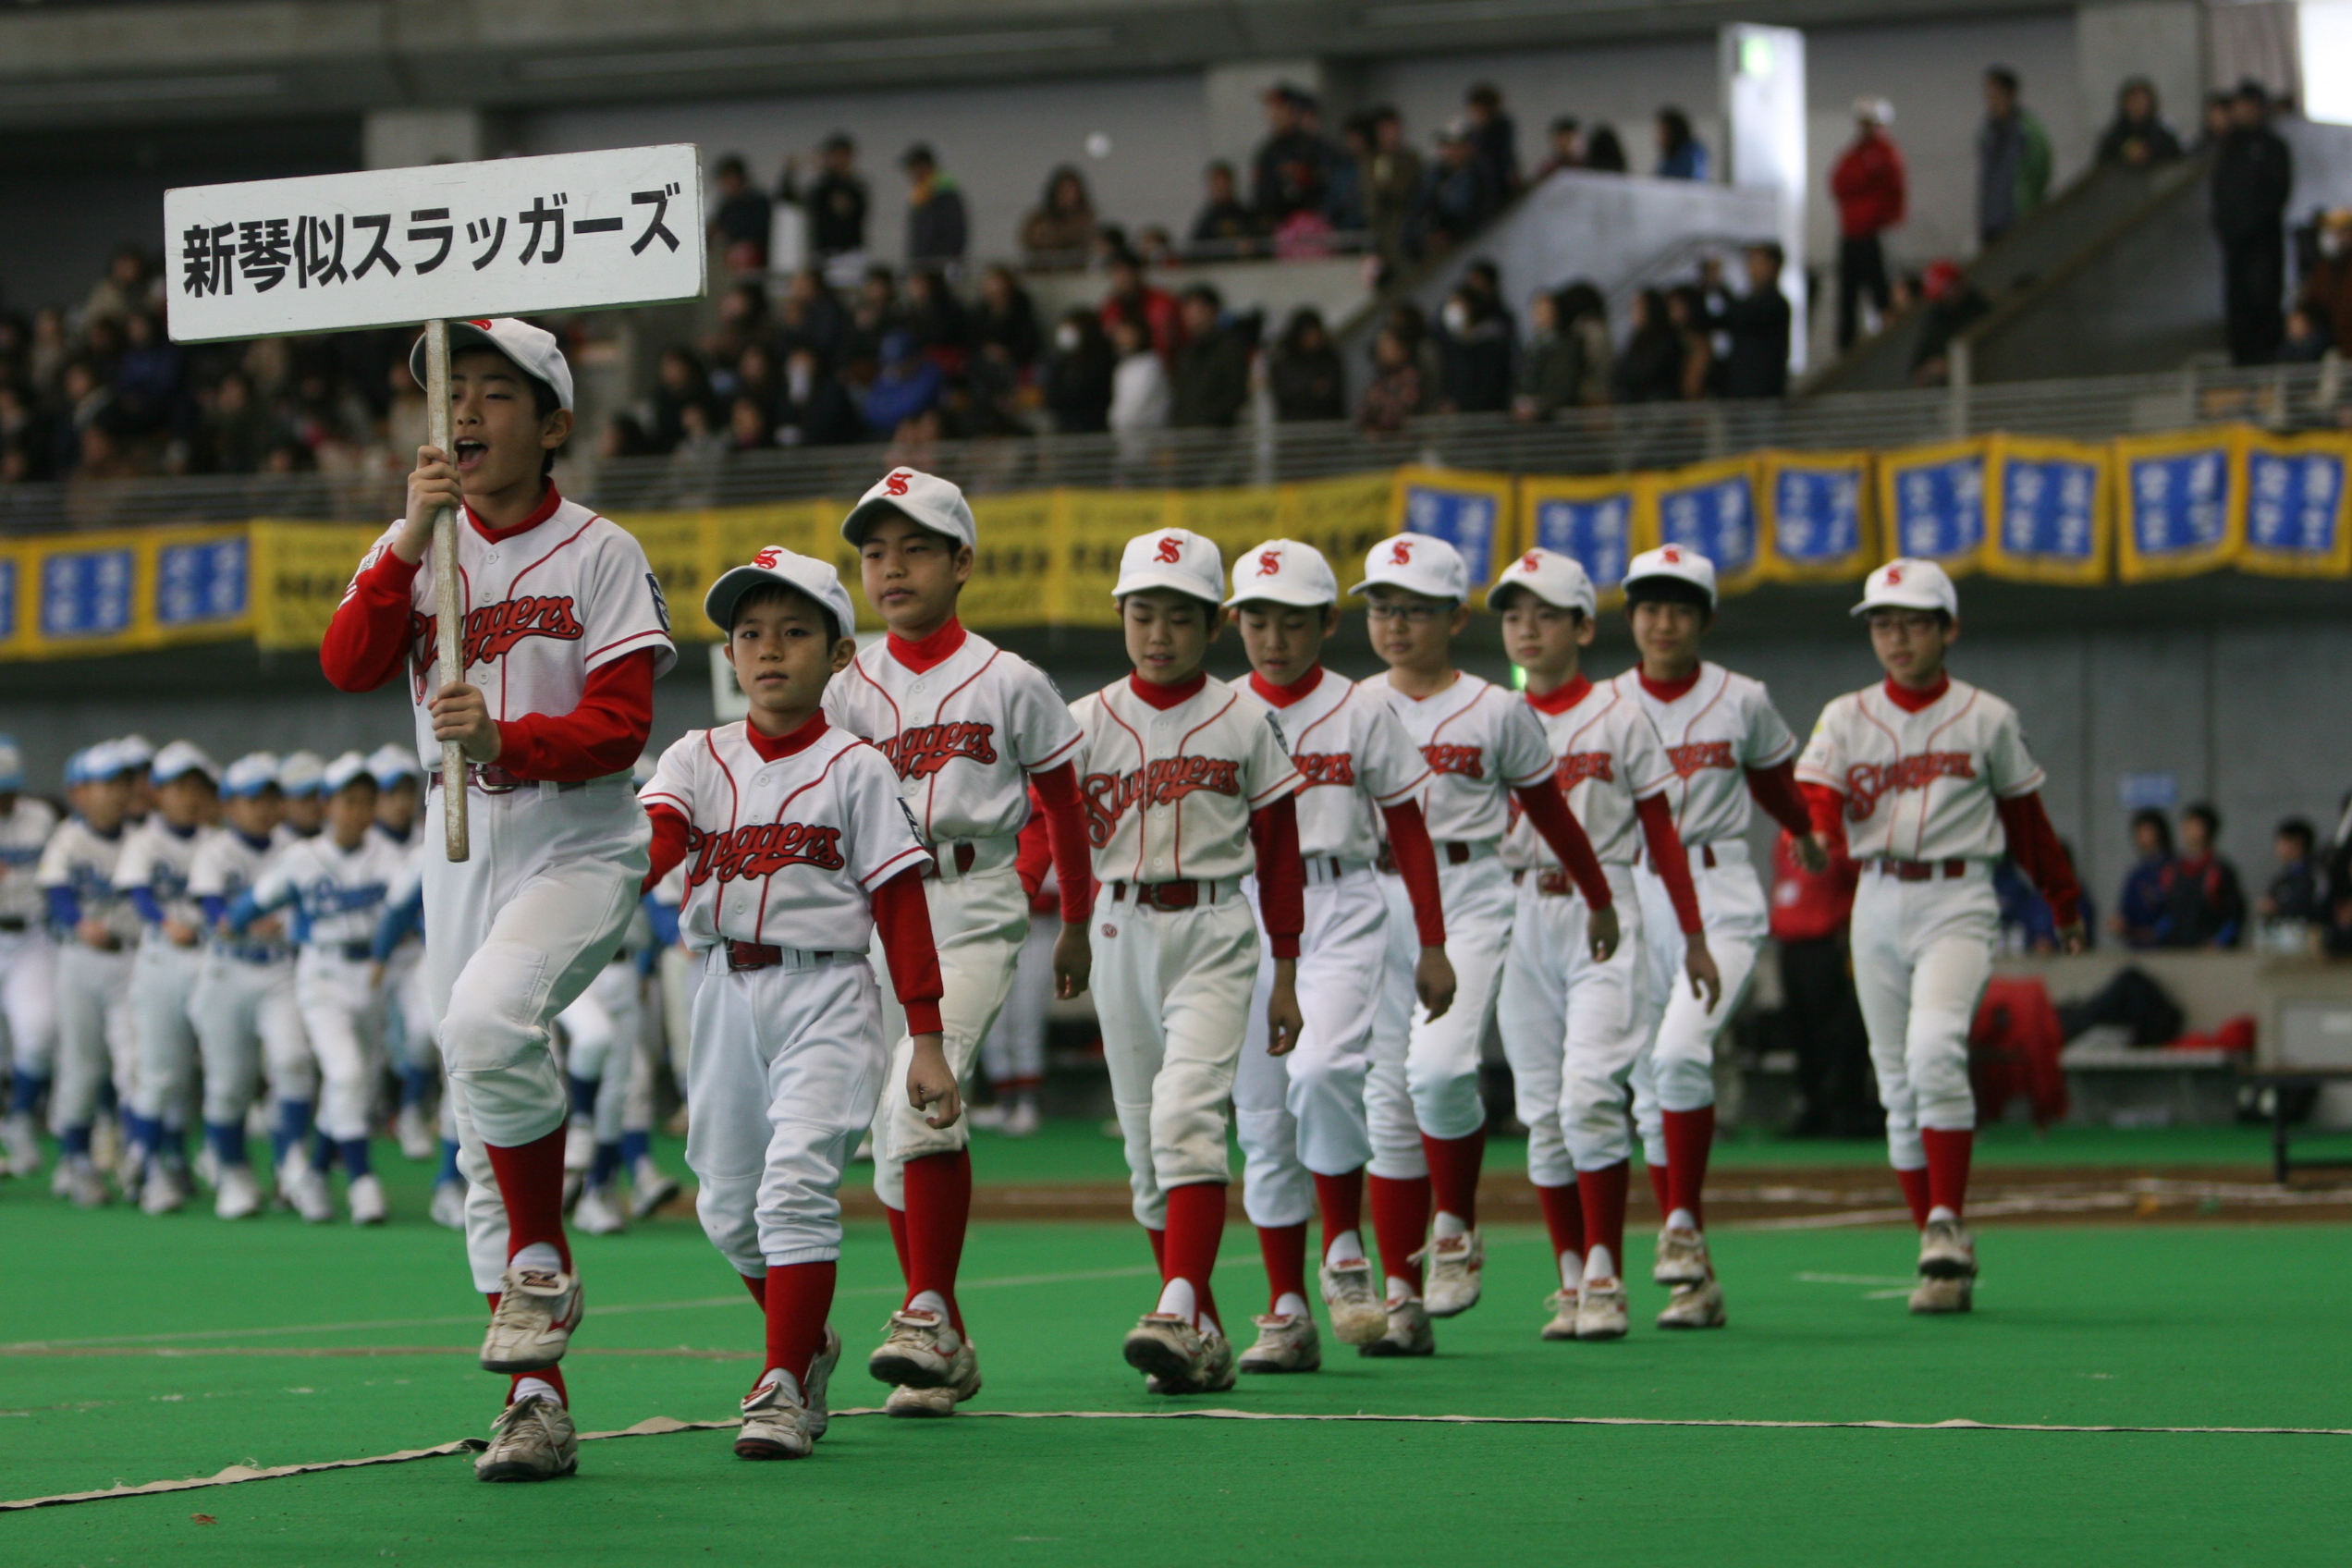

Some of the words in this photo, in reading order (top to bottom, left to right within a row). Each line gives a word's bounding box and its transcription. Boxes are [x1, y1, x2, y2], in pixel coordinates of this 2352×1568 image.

[182, 181, 681, 299] 新琴似スラッガーズ
[883, 472, 913, 496] S
[1153, 536, 1184, 564] S
[1388, 540, 1415, 565] S
[1256, 551, 1281, 577] S
[1883, 565, 1902, 587] S
[1083, 754, 1241, 849] Sluggers
